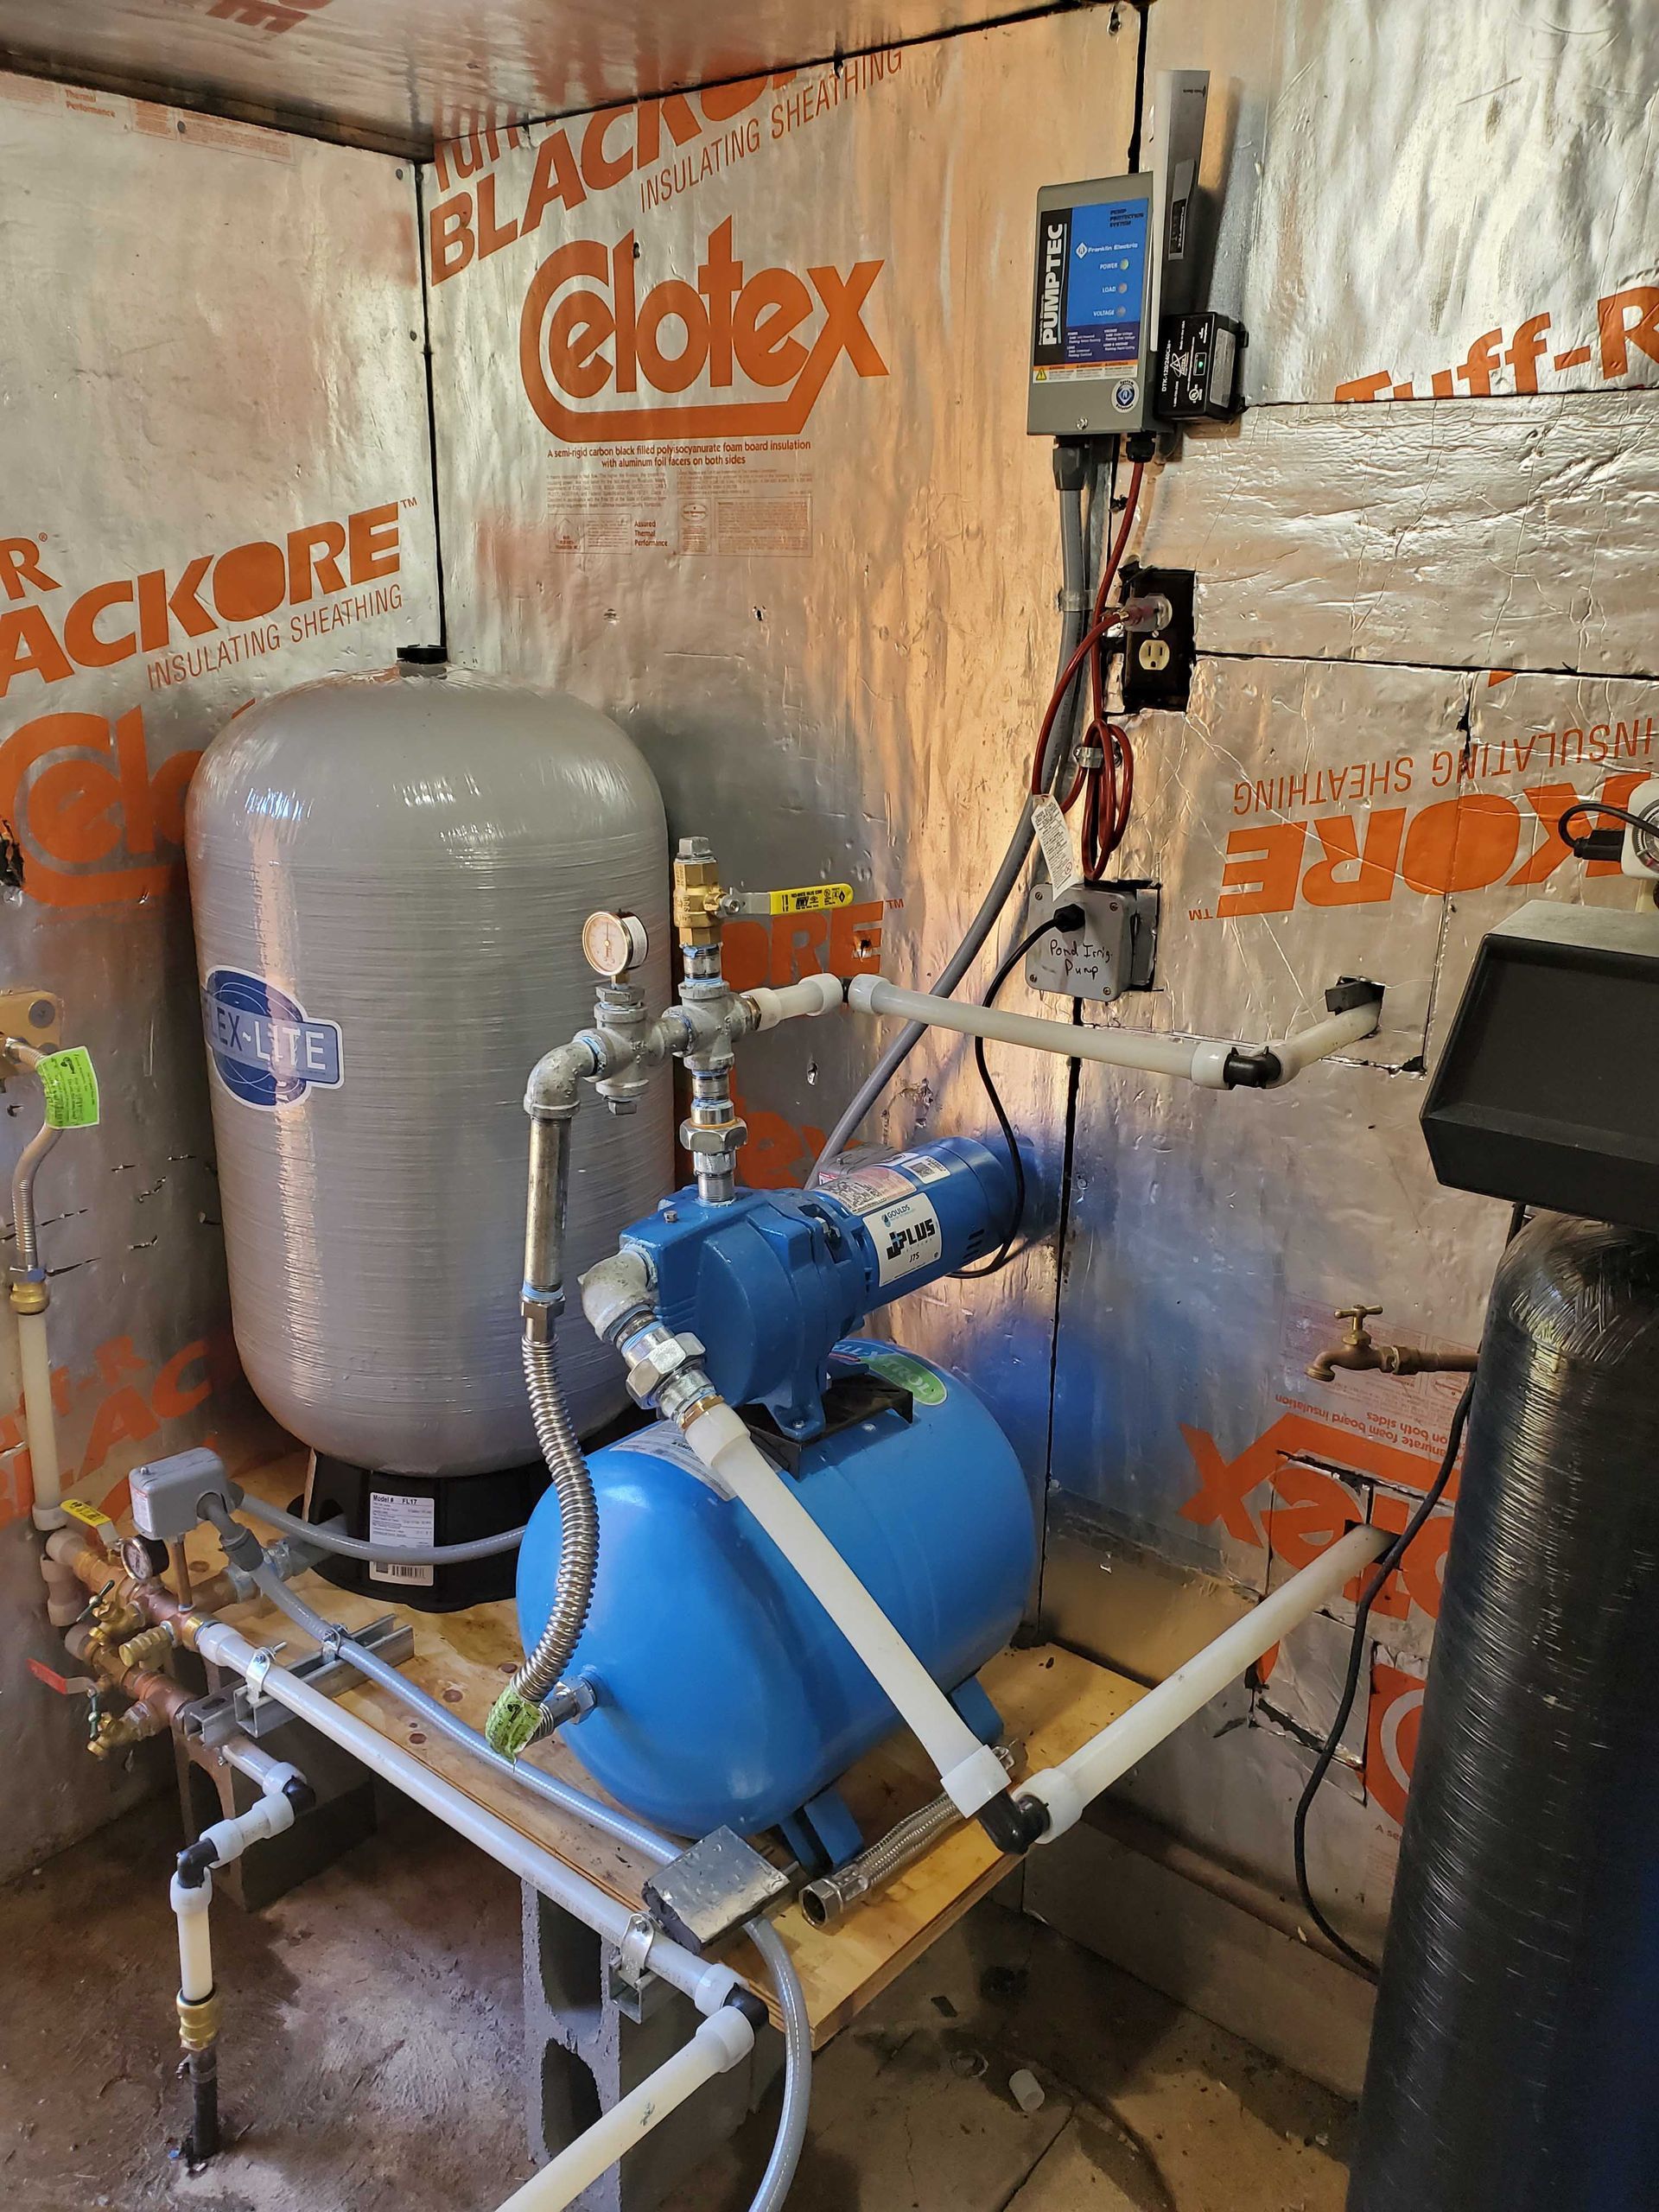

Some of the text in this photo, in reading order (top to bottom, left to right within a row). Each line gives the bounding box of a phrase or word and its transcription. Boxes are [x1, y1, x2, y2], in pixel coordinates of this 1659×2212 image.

[640, 118, 760, 213] INSULATING
[772, 48, 902, 140] SHEATHING
[1042, 224, 1063, 345] PUMPTEC
[519, 215, 889, 442] Celotex
[589, 446, 613, 457] carbon
[615, 446, 635, 456] black
[637, 444, 655, 455] filled
[722, 442, 743, 453] foam
[745, 440, 769, 452] board
[770, 439, 811, 451] insulation
[601, 454, 747, 468] with aluminum foil facers on both sides
[146, 583, 403, 691] INSULATING SHEATHING
[1234, 717, 1652, 816] INSULATING SHEATHING
[1050, 939, 1078, 957] Pond
[1065, 959, 1100, 980] Pump
[887, 1204, 911, 1218] GOULDS
[1275, 1394, 1328, 1417] insulation
[1332, 1412, 1365, 1433] board
[1369, 1424, 1399, 1445] foam
[1367, 1411, 1448, 1446] sides both on
[372, 1494, 390, 1503] Model
